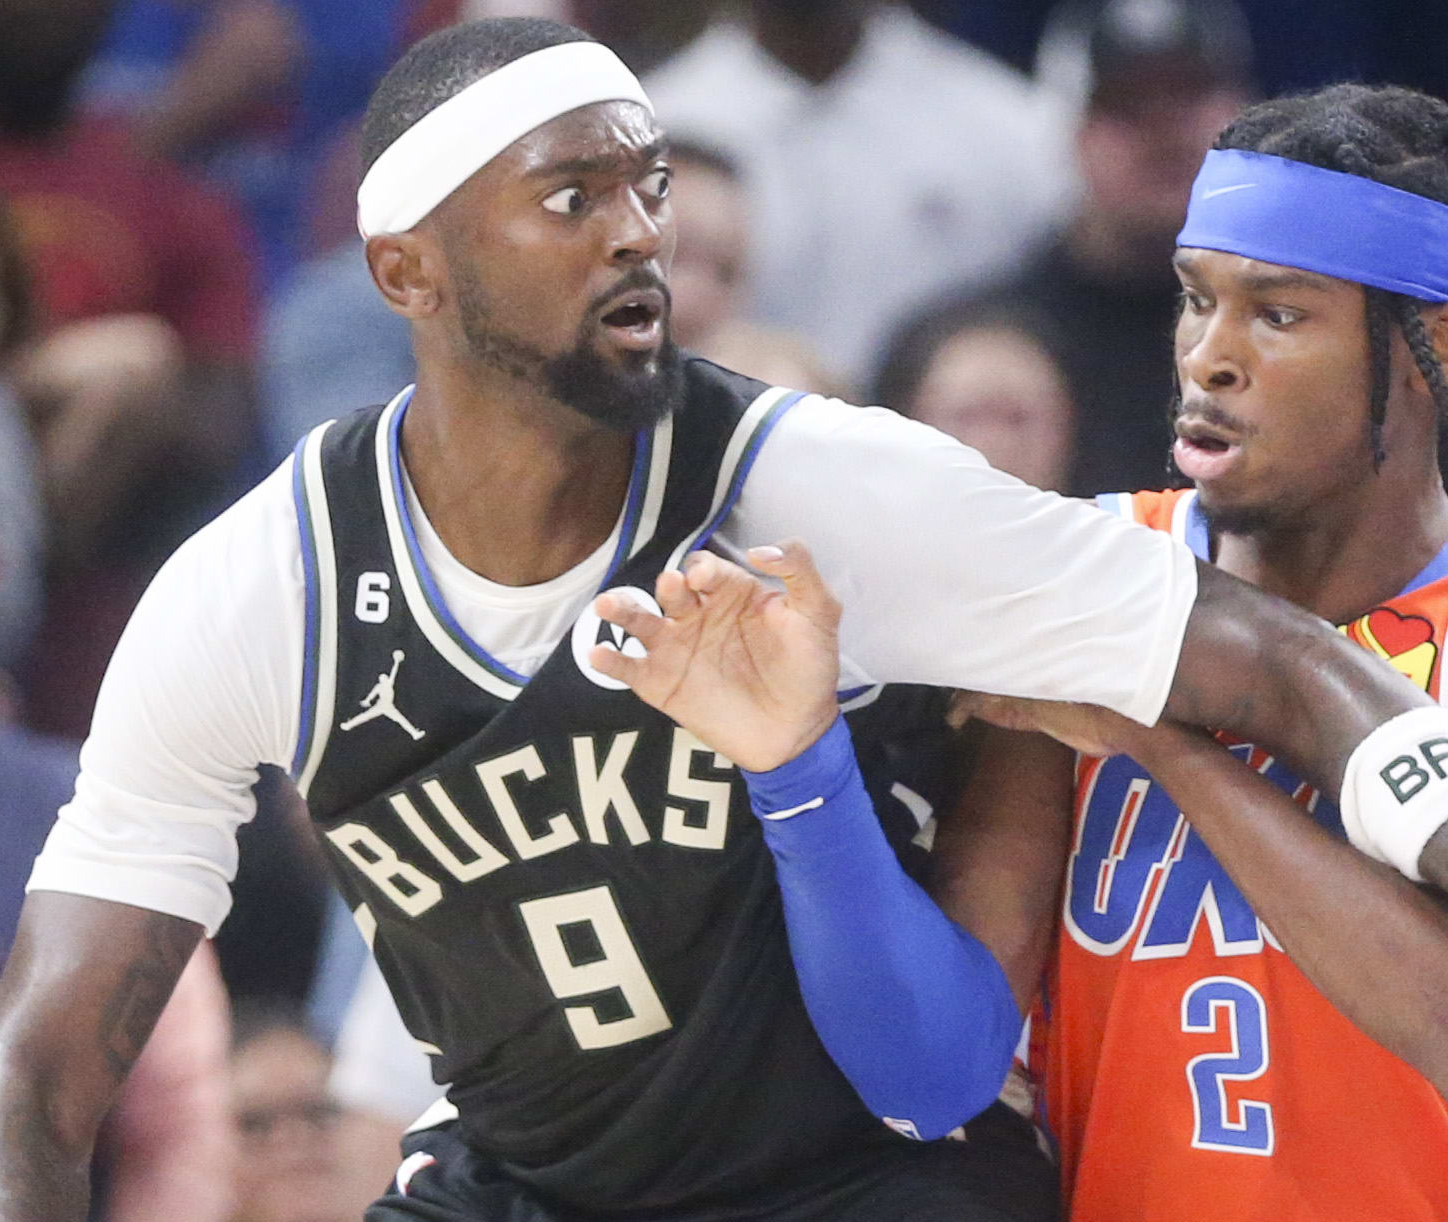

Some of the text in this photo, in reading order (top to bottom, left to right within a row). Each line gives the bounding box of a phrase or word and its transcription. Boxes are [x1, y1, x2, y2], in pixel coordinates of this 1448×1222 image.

[354, 571, 390, 624] 6
[325, 726, 733, 918] BUCKS
[518, 885, 673, 1051] 9
[1180, 975, 1275, 1157] 2
